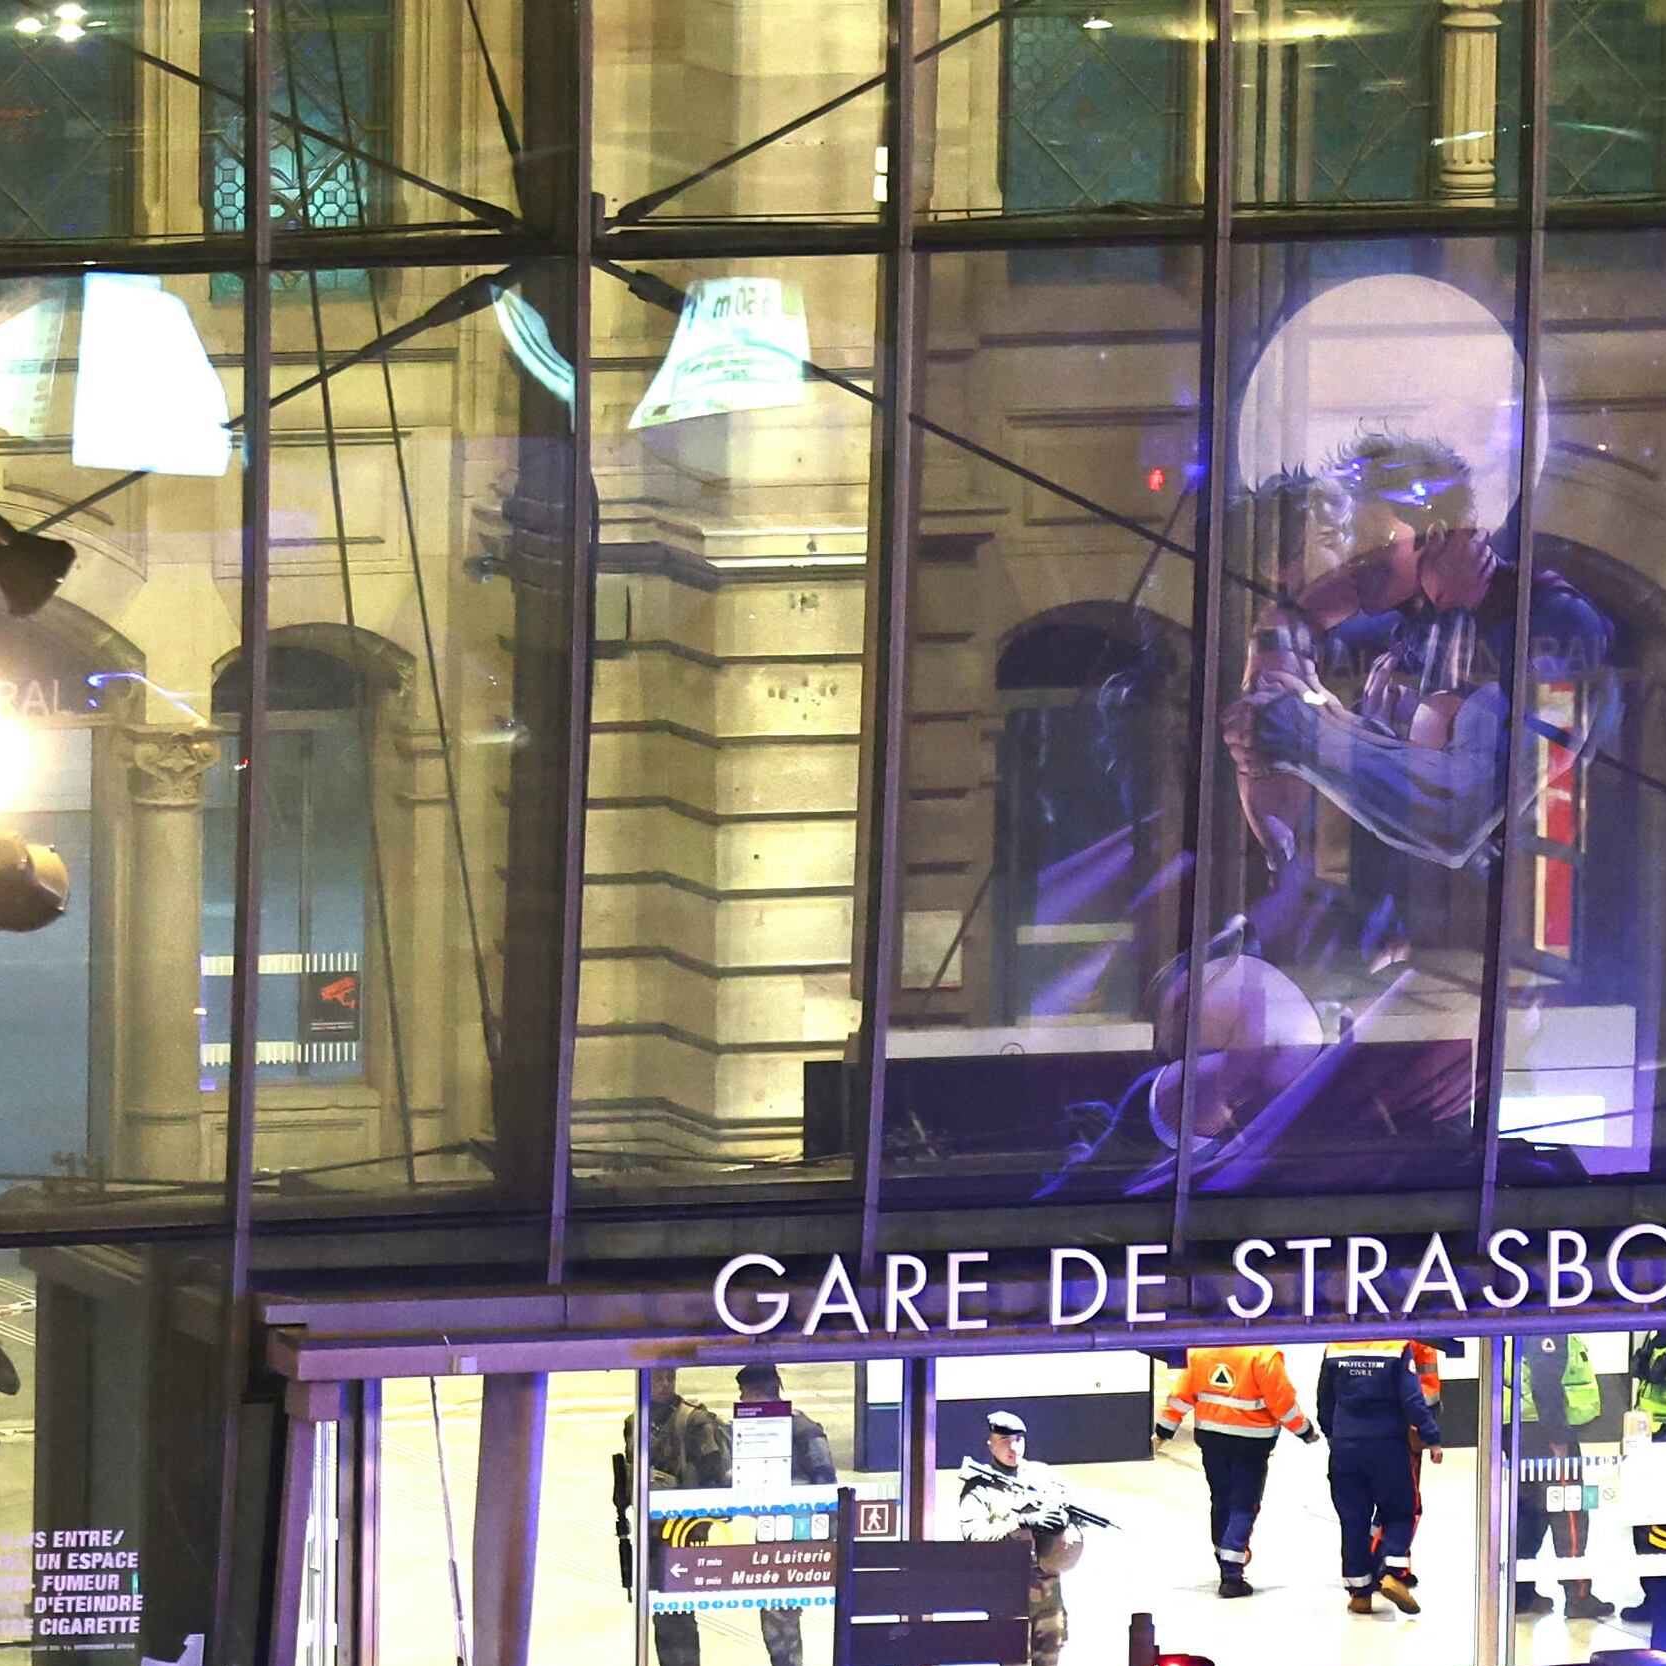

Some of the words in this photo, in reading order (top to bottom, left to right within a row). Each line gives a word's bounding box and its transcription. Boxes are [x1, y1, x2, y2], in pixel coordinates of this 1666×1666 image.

[713, 1251, 989, 1336] GARE
[1050, 1243, 1167, 1326] DE
[35, 1553, 61, 1570] UN
[67, 1552, 139, 1569] ESPACE
[752, 1551, 771, 1565] La
[774, 1549, 832, 1564] Laiterie
[42, 1574, 120, 1592] FUMEUR
[731, 1570, 780, 1584] Musée
[787, 1568, 832, 1582] Vodou
[34, 1594, 144, 1613] D'ÉTEINDRE
[39, 1616, 141, 1636] CIGARETTE
